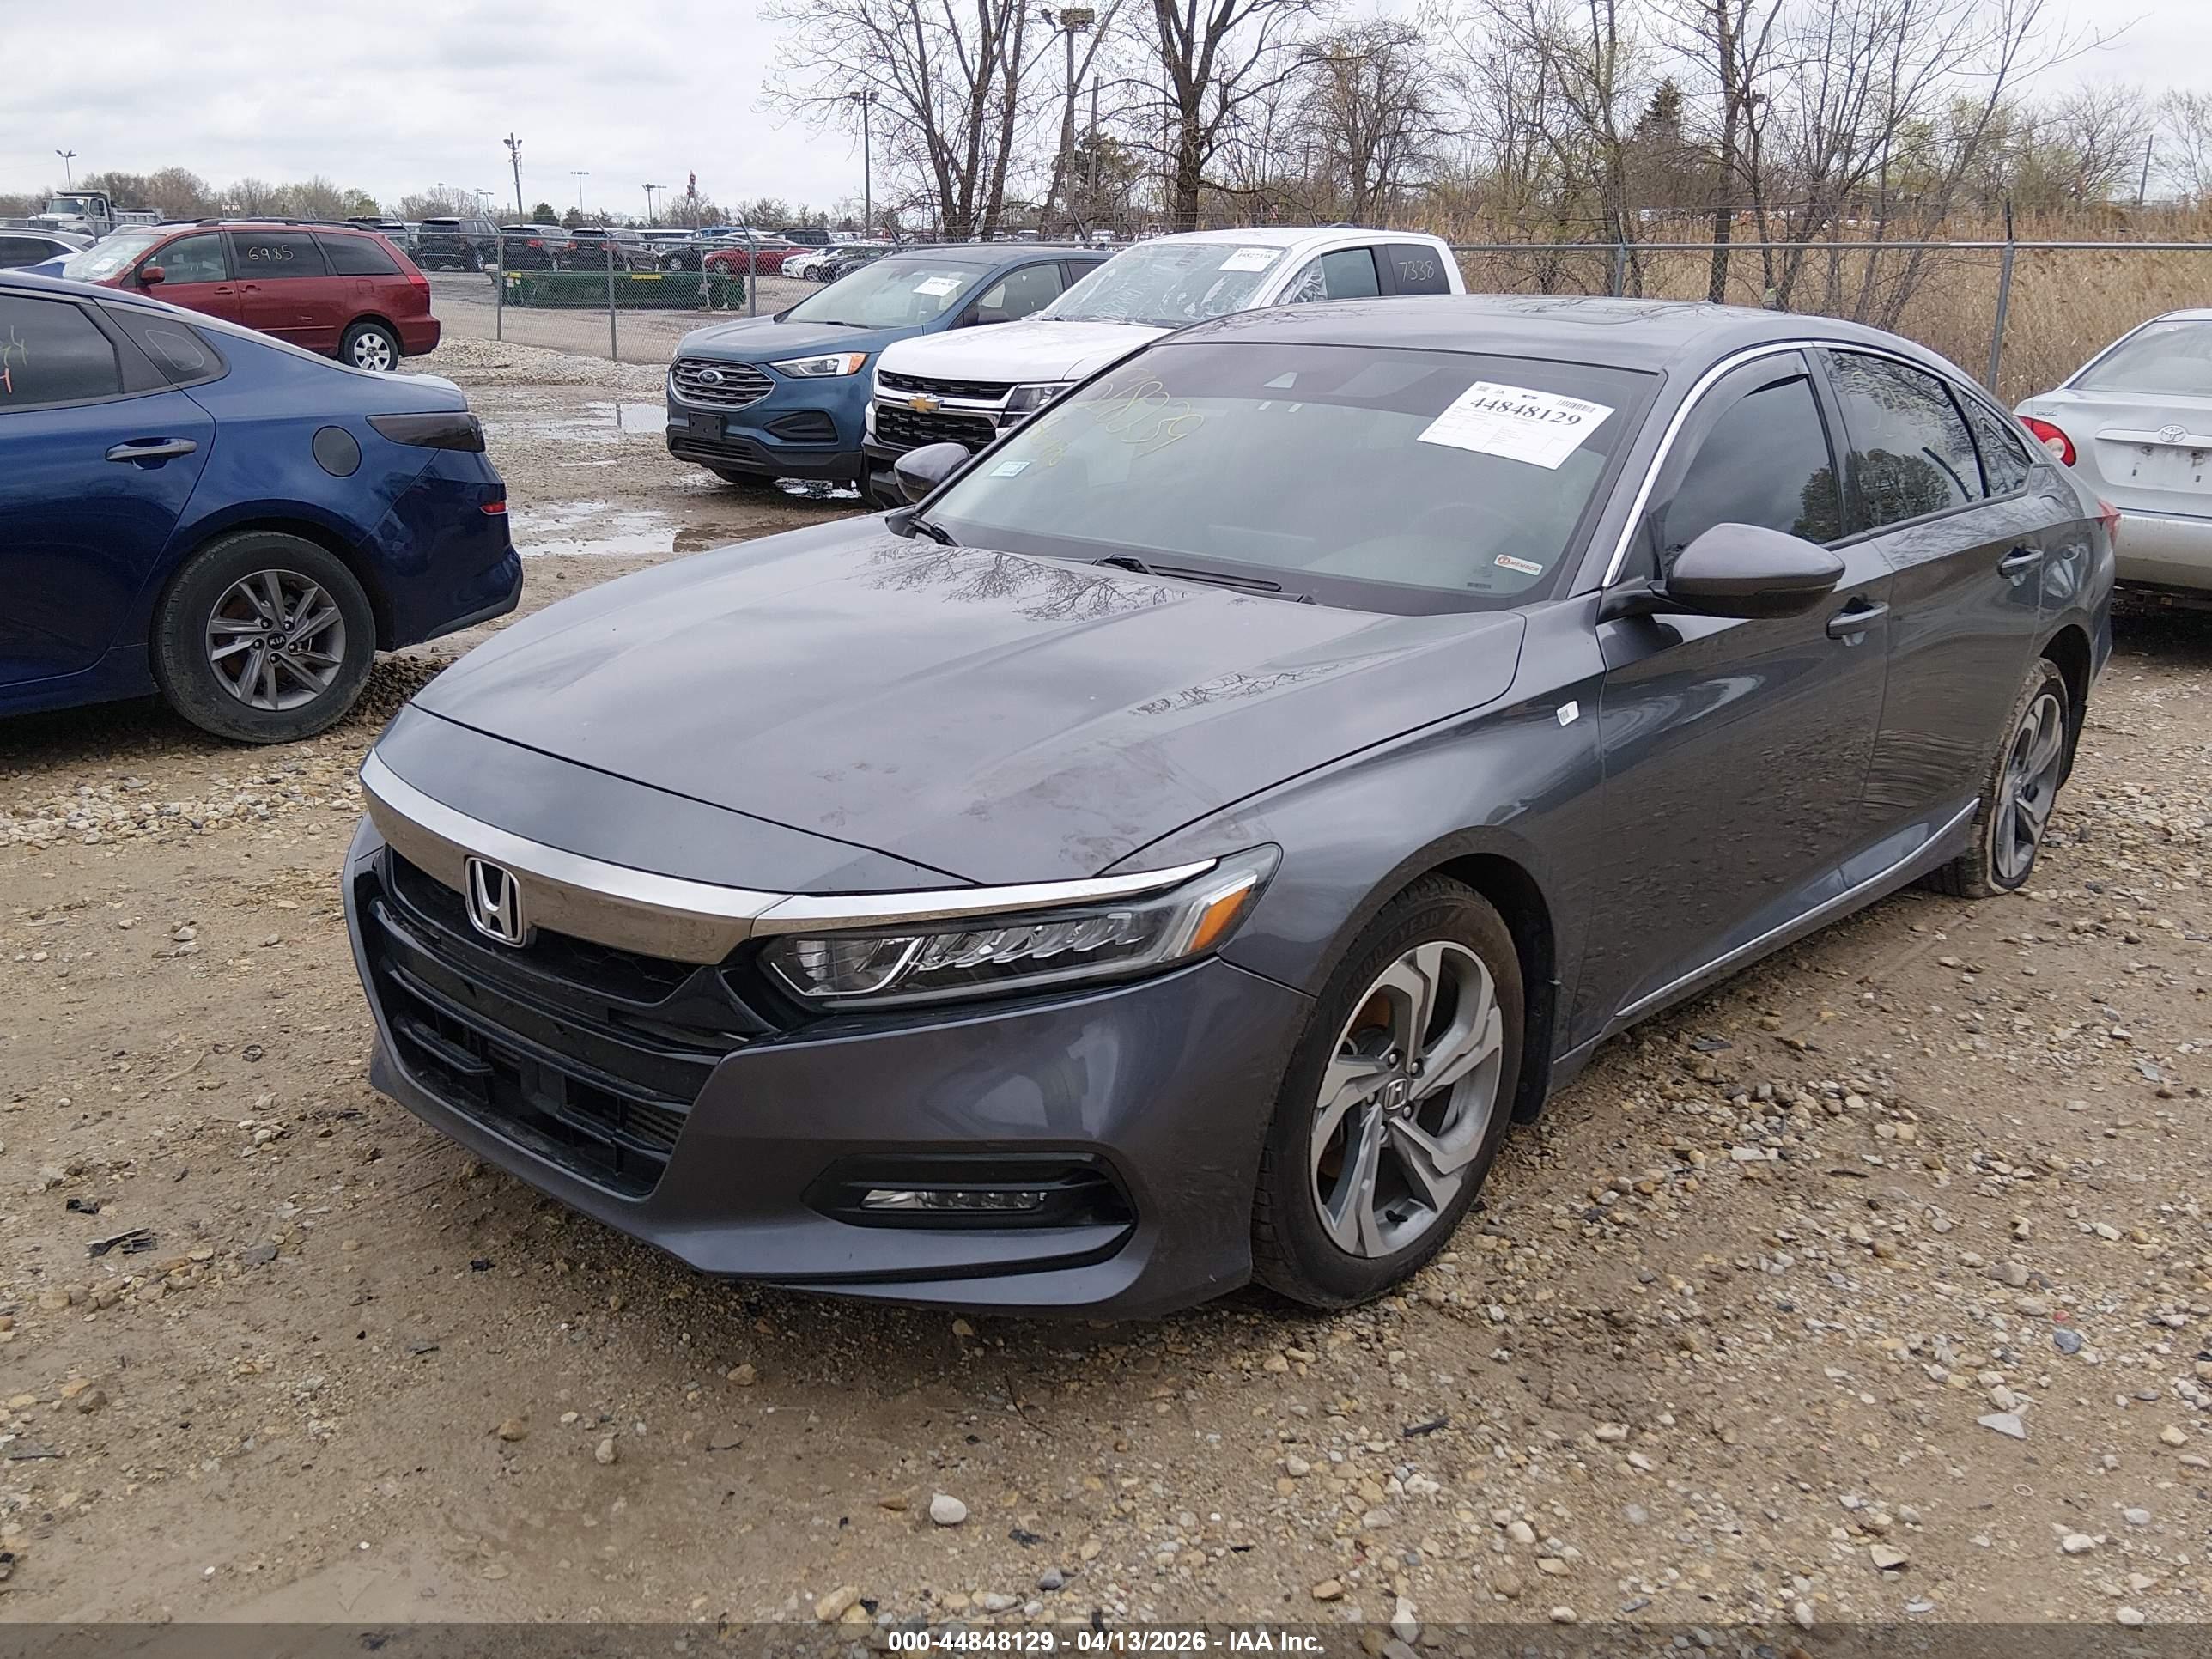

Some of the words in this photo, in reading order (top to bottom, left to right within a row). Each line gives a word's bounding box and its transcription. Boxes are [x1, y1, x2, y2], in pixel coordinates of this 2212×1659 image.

[248, 245, 294, 262] 6985
[1398, 260, 1435, 282] 7338
[1470, 398, 1583, 427] 44848129
[270, 636, 286, 646] KIA
